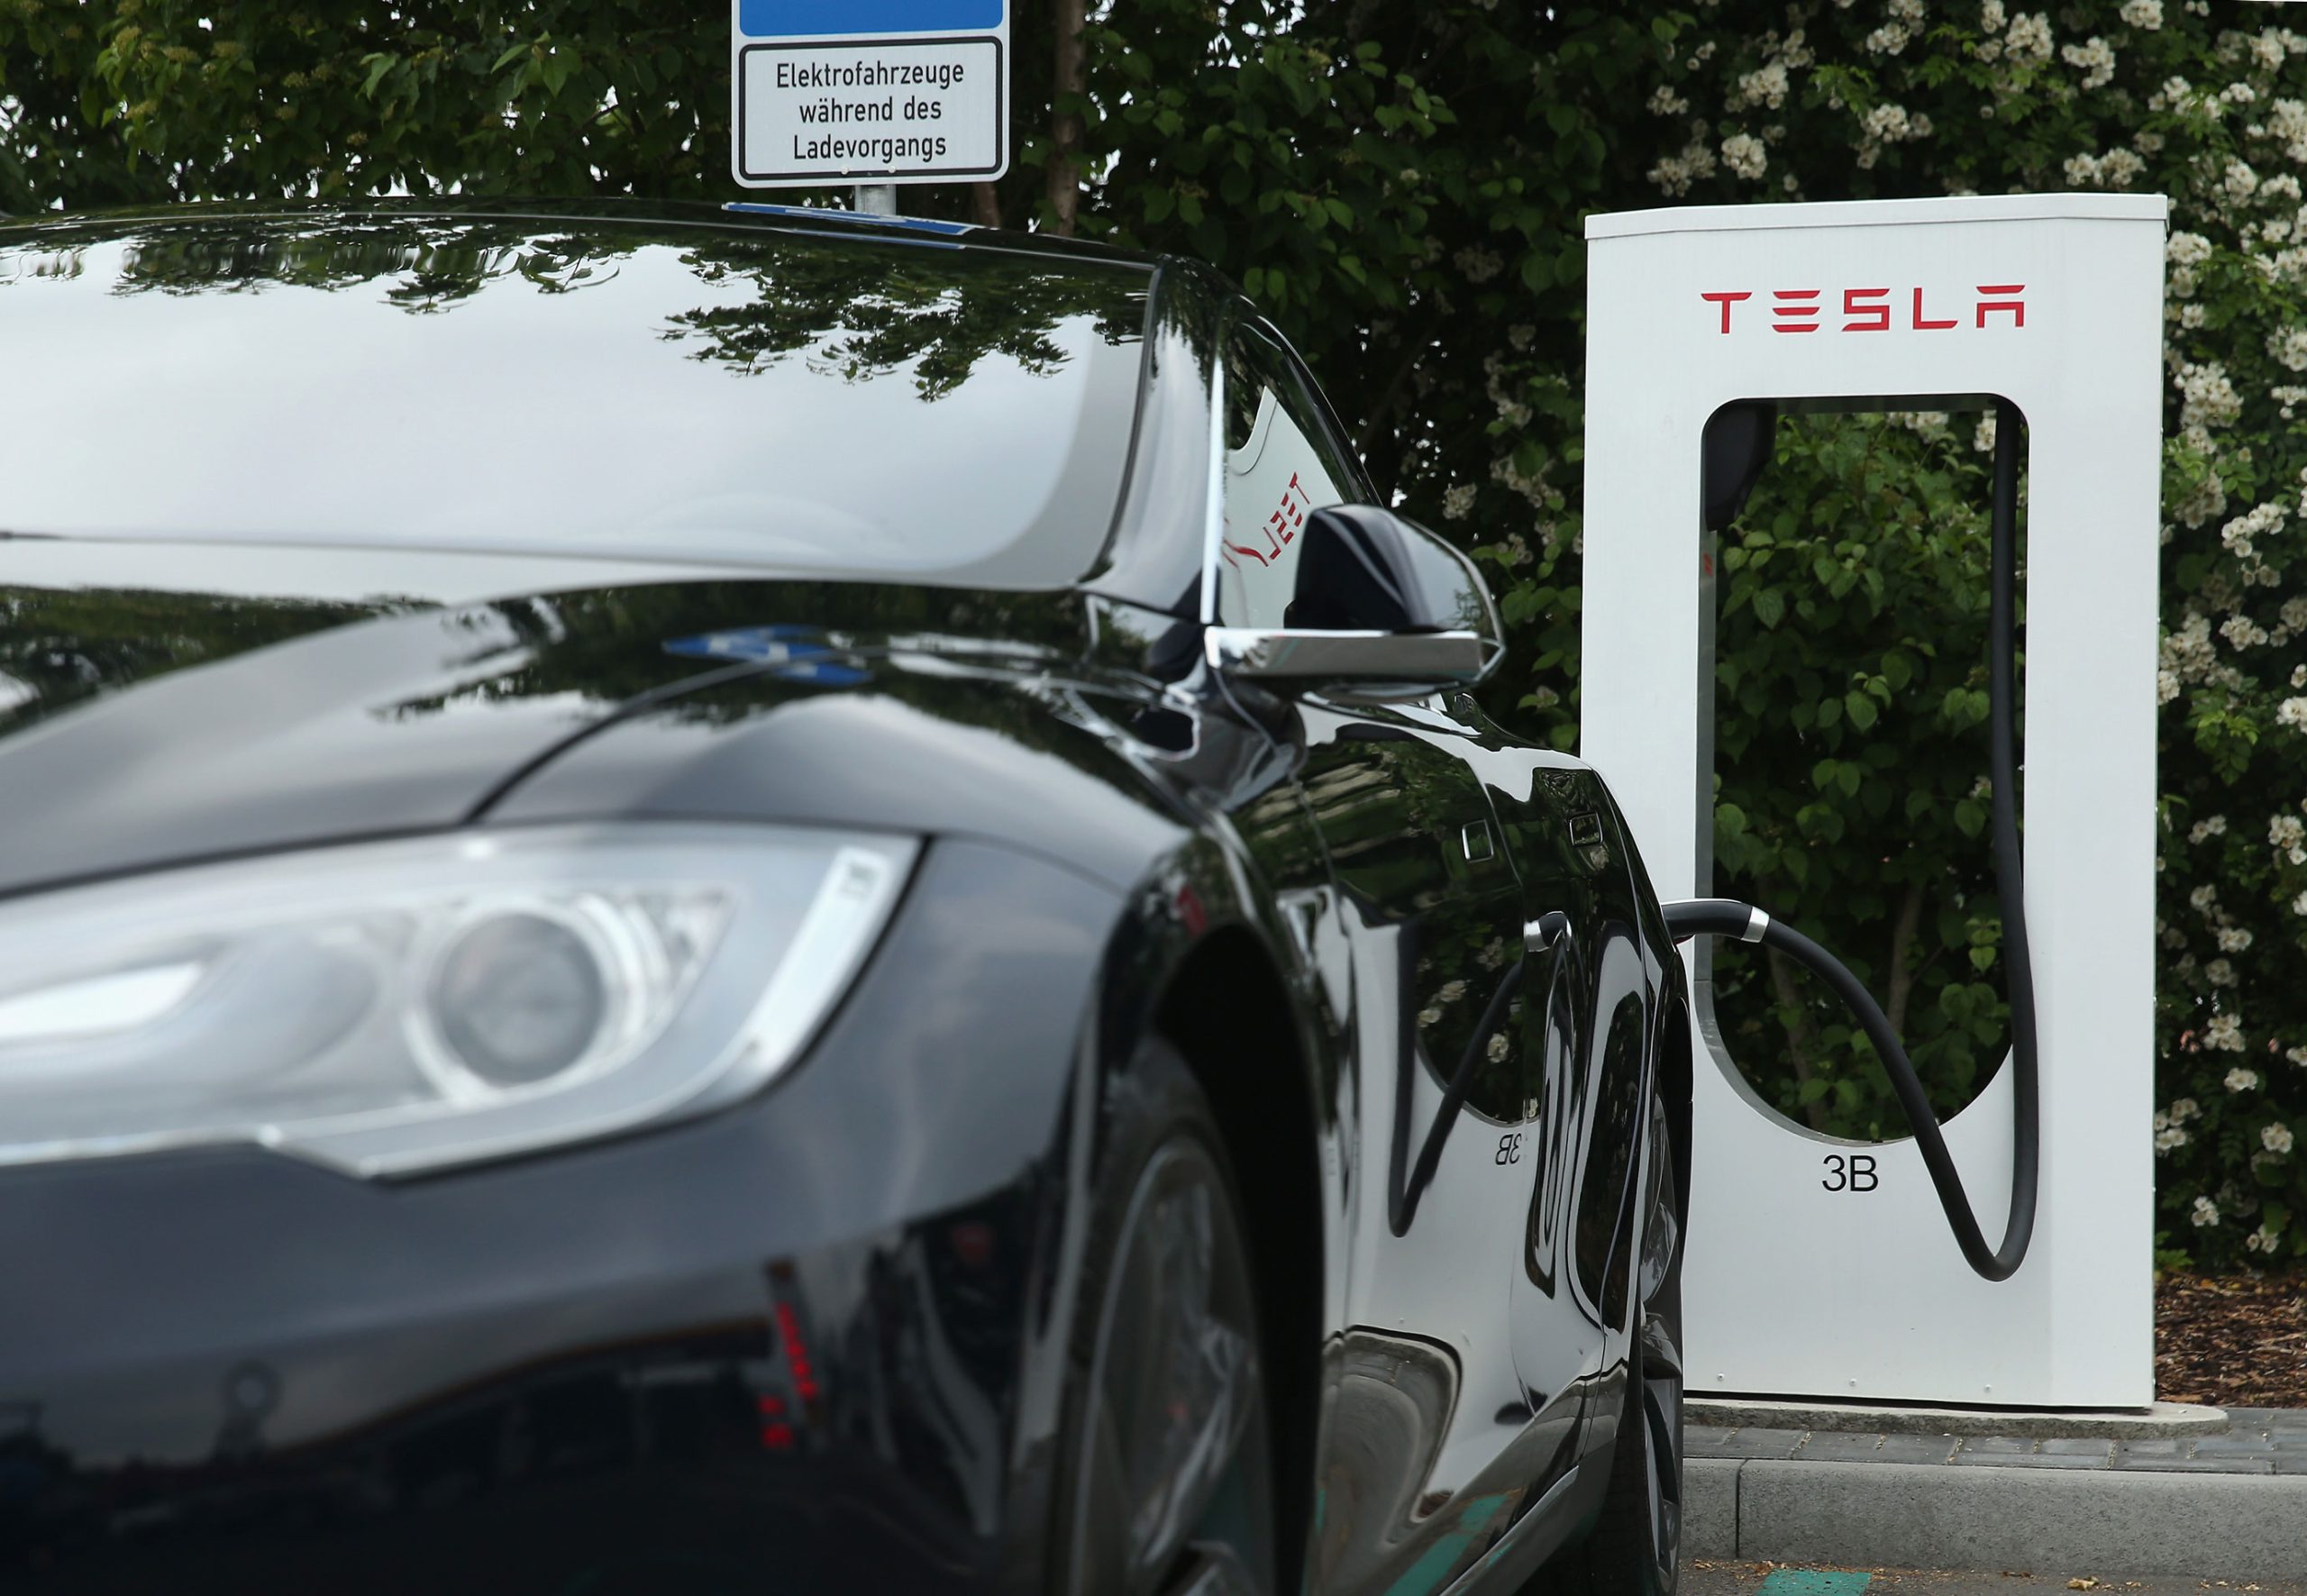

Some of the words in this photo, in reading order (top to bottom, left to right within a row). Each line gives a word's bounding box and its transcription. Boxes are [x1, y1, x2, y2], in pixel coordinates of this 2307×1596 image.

[777, 60, 964, 89] Elektrofahrzeuge
[799, 96, 893, 123] während
[904, 96, 942, 120] des
[794, 134, 946, 163] Ladevorgangs
[1701, 285, 2026, 334] TESLA
[1821, 1154, 1879, 1192] 3B
